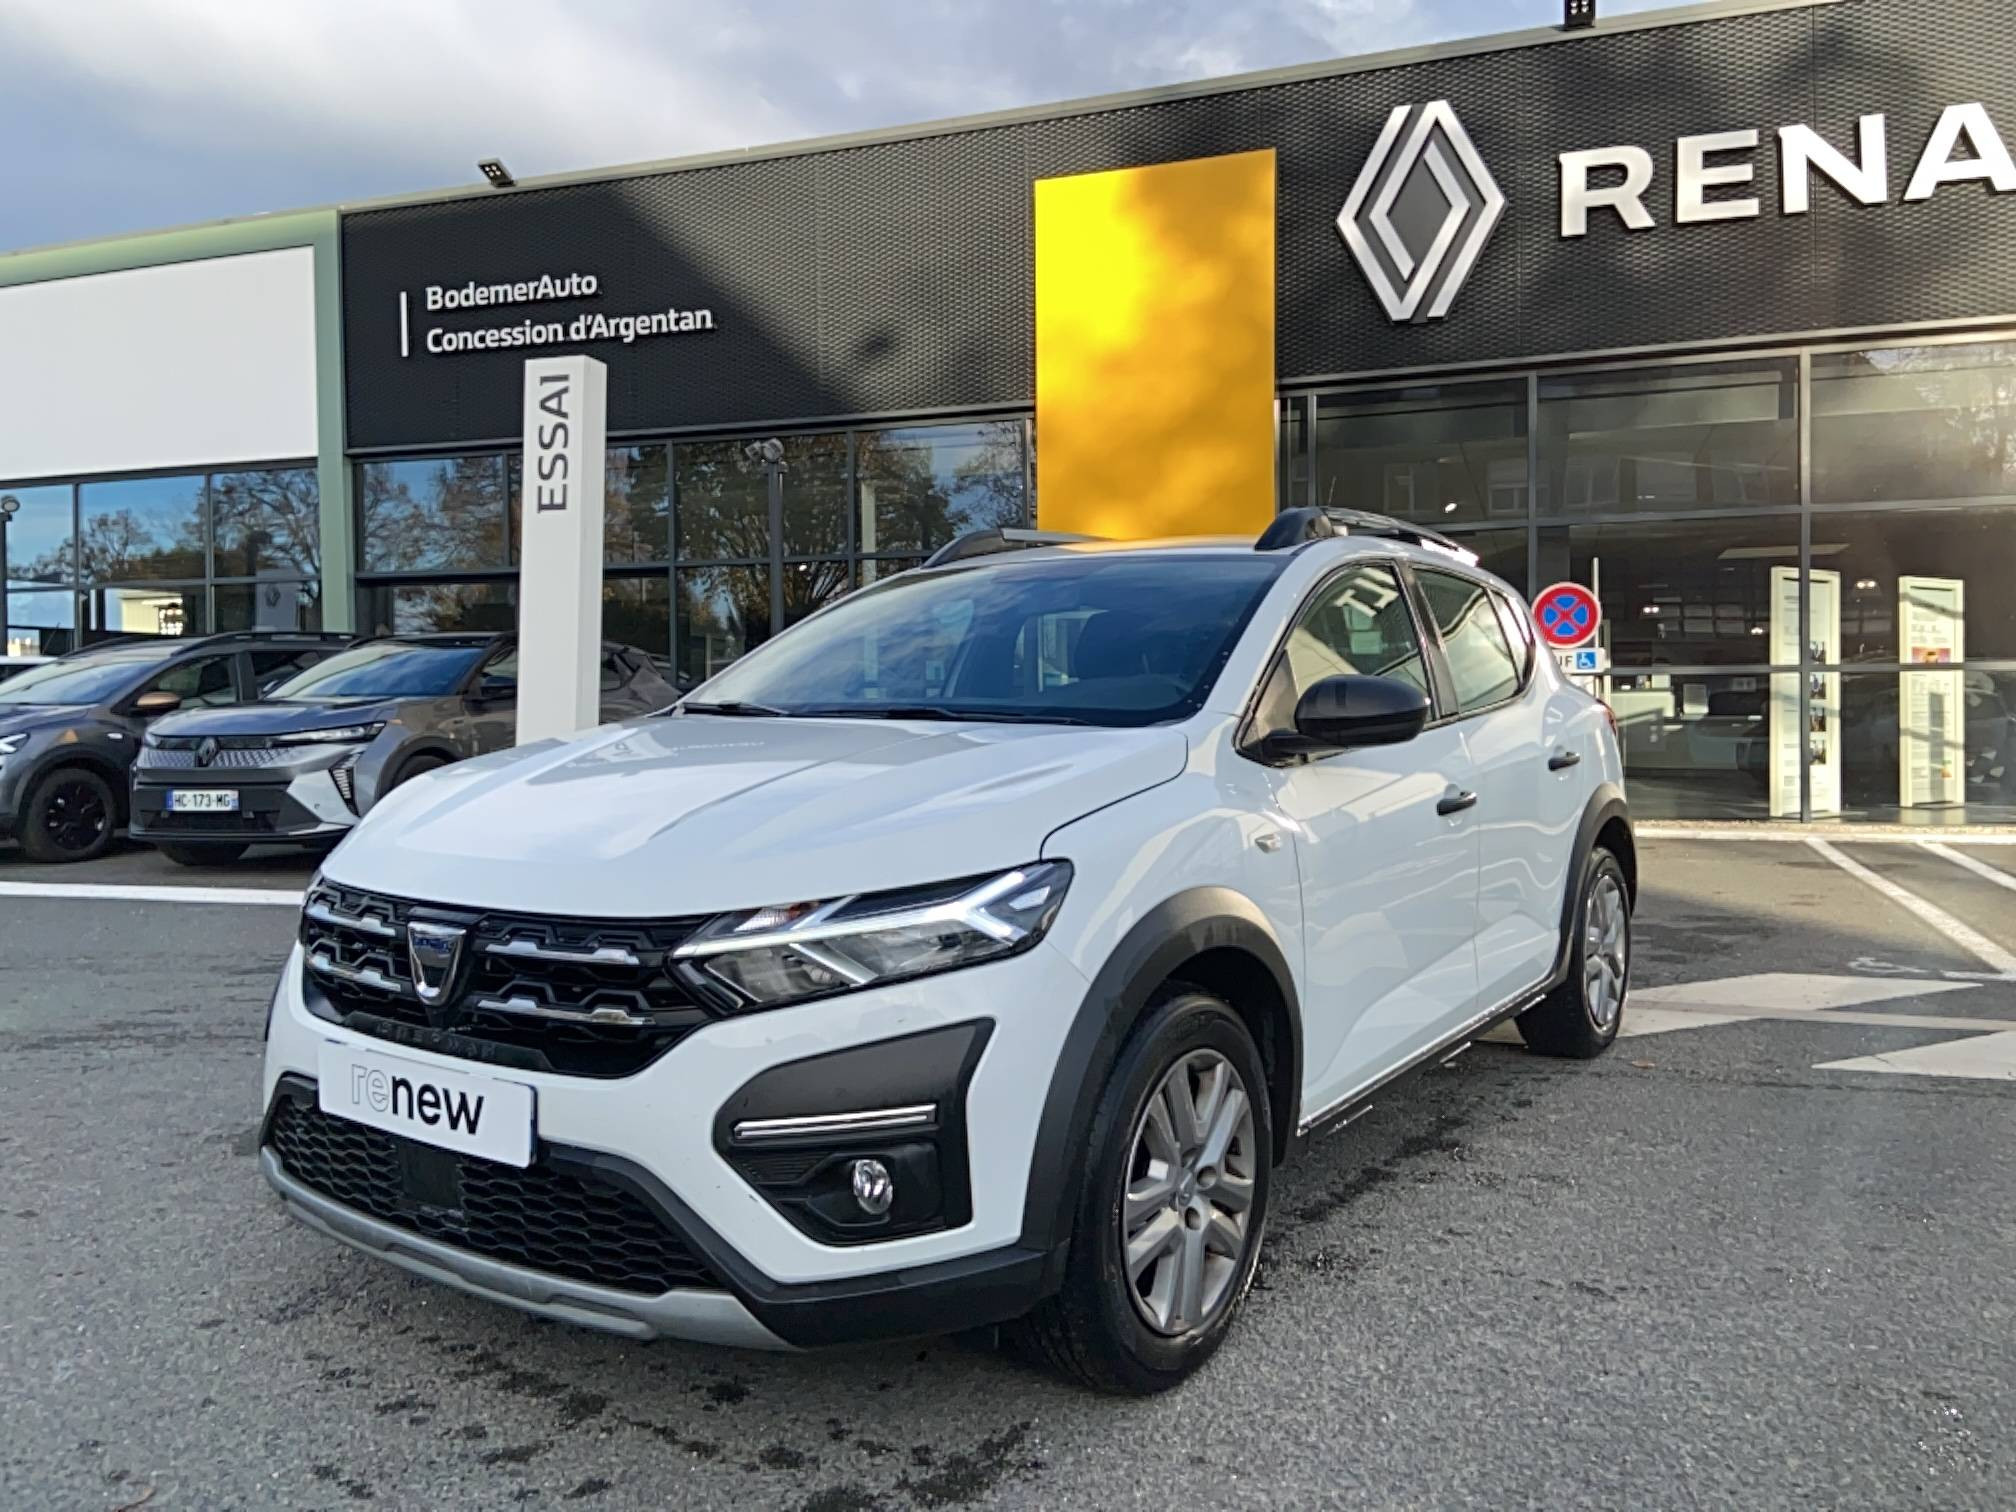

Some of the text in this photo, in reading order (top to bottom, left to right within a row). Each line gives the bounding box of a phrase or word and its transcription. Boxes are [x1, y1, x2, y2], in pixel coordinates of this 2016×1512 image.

[1558, 102, 2016, 237] RENA
[425, 272, 598, 310] BodemerAuto
[426, 308, 714, 353] Concession d'Argentan
[536, 374, 570, 514] ESSAI
[350, 1063, 485, 1136] renew
